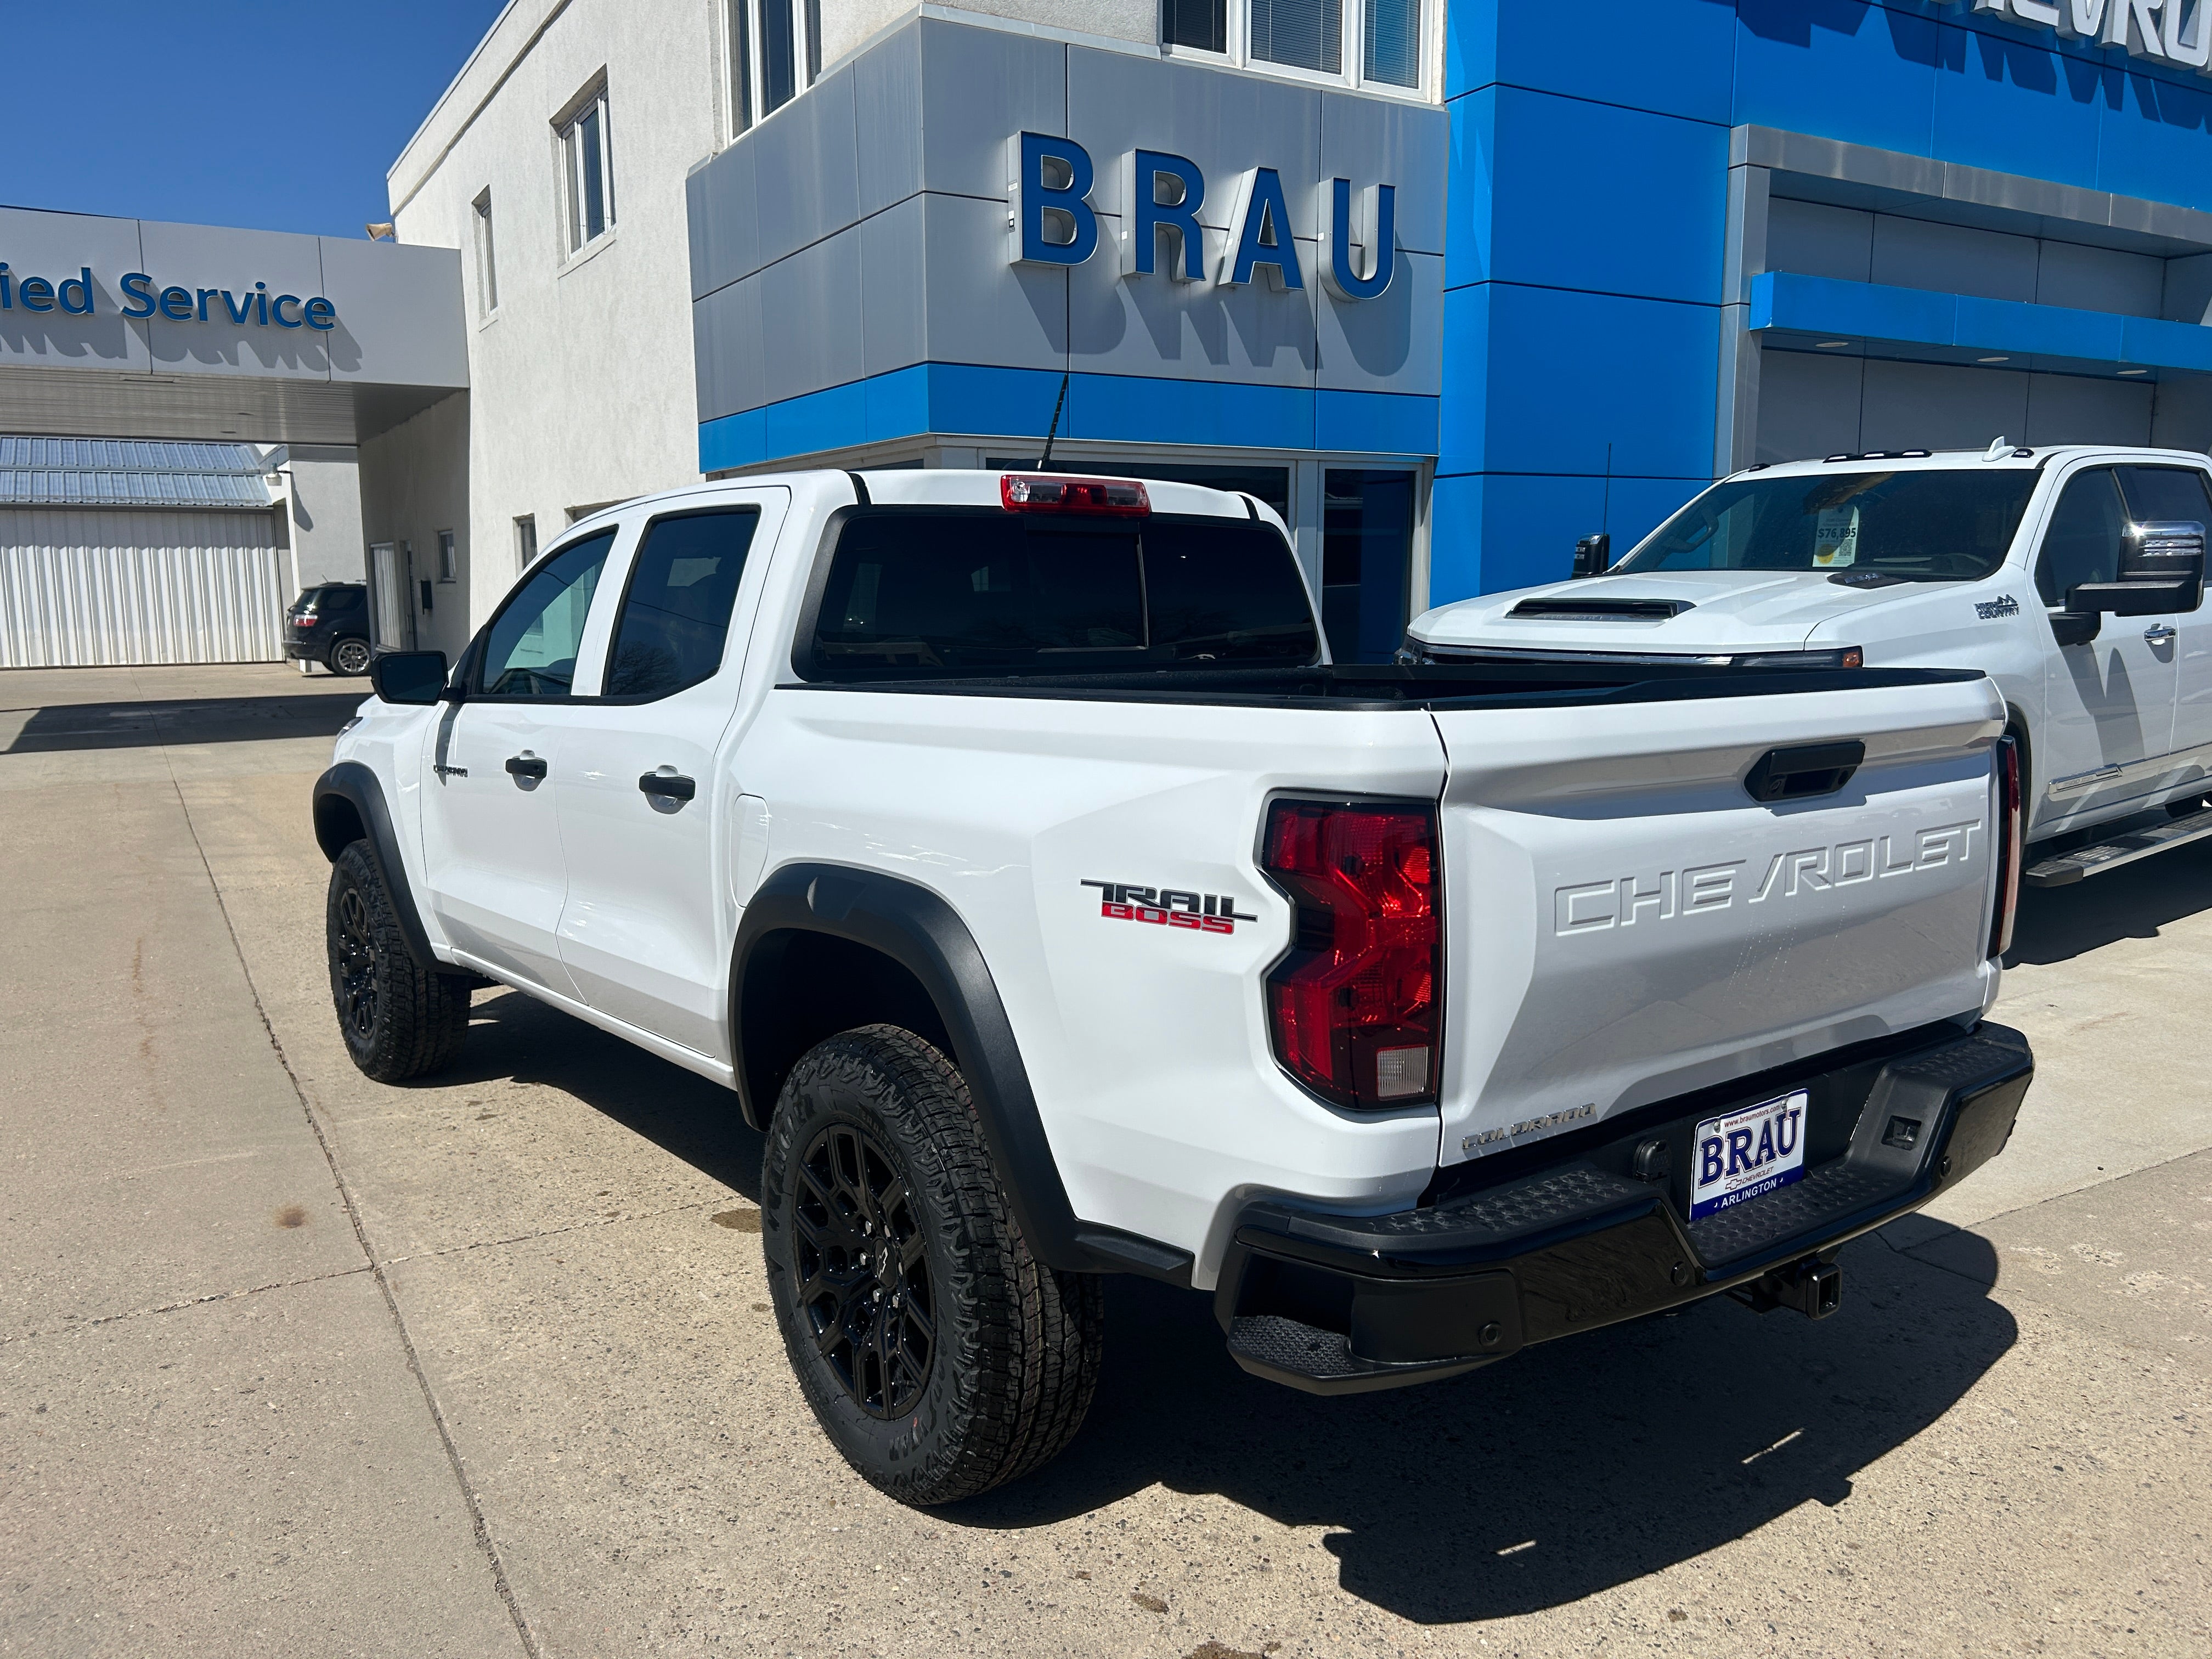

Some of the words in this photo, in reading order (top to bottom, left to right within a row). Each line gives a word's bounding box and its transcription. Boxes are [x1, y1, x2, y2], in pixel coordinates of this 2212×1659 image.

[1008, 131, 1395, 301] BRAU
[119, 272, 336, 331] Service
[1818, 527, 1856, 540] $76,895
[1555, 819, 1981, 936] CHEVROLET
[1080, 878, 1258, 923] TRAIL
[1101, 901, 1234, 935] BOSS
[1462, 1103, 1595, 1149] COLORADO
[1724, 1104, 1780, 1127] www.braumotors.com
[1698, 1107, 1802, 1189] BRAU
[1721, 1178, 1777, 1208] ARLINGTON
[1742, 1166, 1774, 1184] CHEVROLET
